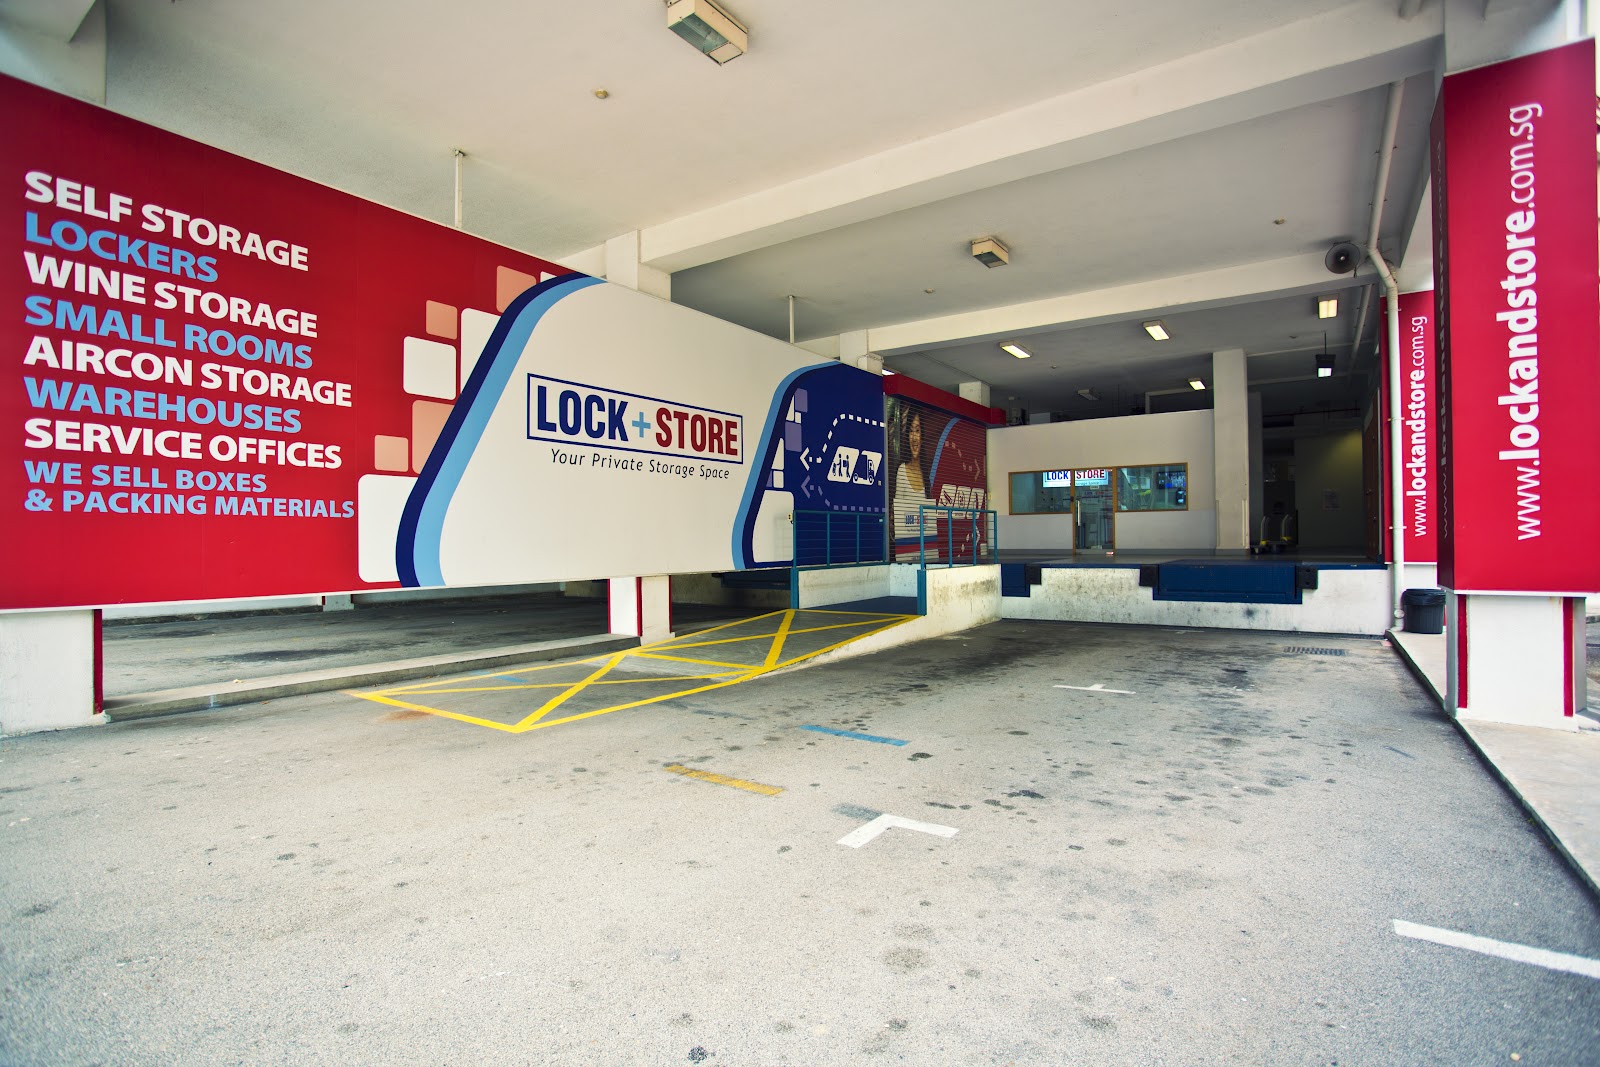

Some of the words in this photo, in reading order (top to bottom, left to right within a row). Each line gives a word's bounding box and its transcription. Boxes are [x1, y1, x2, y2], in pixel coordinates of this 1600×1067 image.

[24, 171, 133, 222] SELF
[141, 203, 309, 272] STORAGE
[25, 211, 219, 283] LOCKERS
[23, 250, 147, 305] WINE
[153, 281, 318, 338] STORAGE
[1496, 103, 1542, 540] www.lockandstore.com.sg
[24, 295, 177, 347] SMALL
[184, 323, 313, 370] ROOMS
[23, 335, 193, 386] AIRCON
[200, 362, 353, 407] STORAGE
[23, 376, 302, 434] WAREHOUSES
[24, 417, 203, 460] SERVICE
[208, 434, 343, 470] OFFICES
[1406, 316, 1428, 537] www.lockandstore.com.sg
[23, 460, 83, 485] WE
[91, 465, 168, 489] SELL
[175, 470, 267, 493] BOXES
[551, 448, 586, 466] Your
[592, 453, 644, 472] Private
[649, 459, 695, 479] Storage
[700, 464, 730, 480] Space
[1047, 471, 1068, 480] LOCK
[1076, 470, 1104, 479] STORE
[24, 489, 53, 512] &
[63, 490, 207, 515] PACKING
[214, 496, 355, 519] MATERIALS
